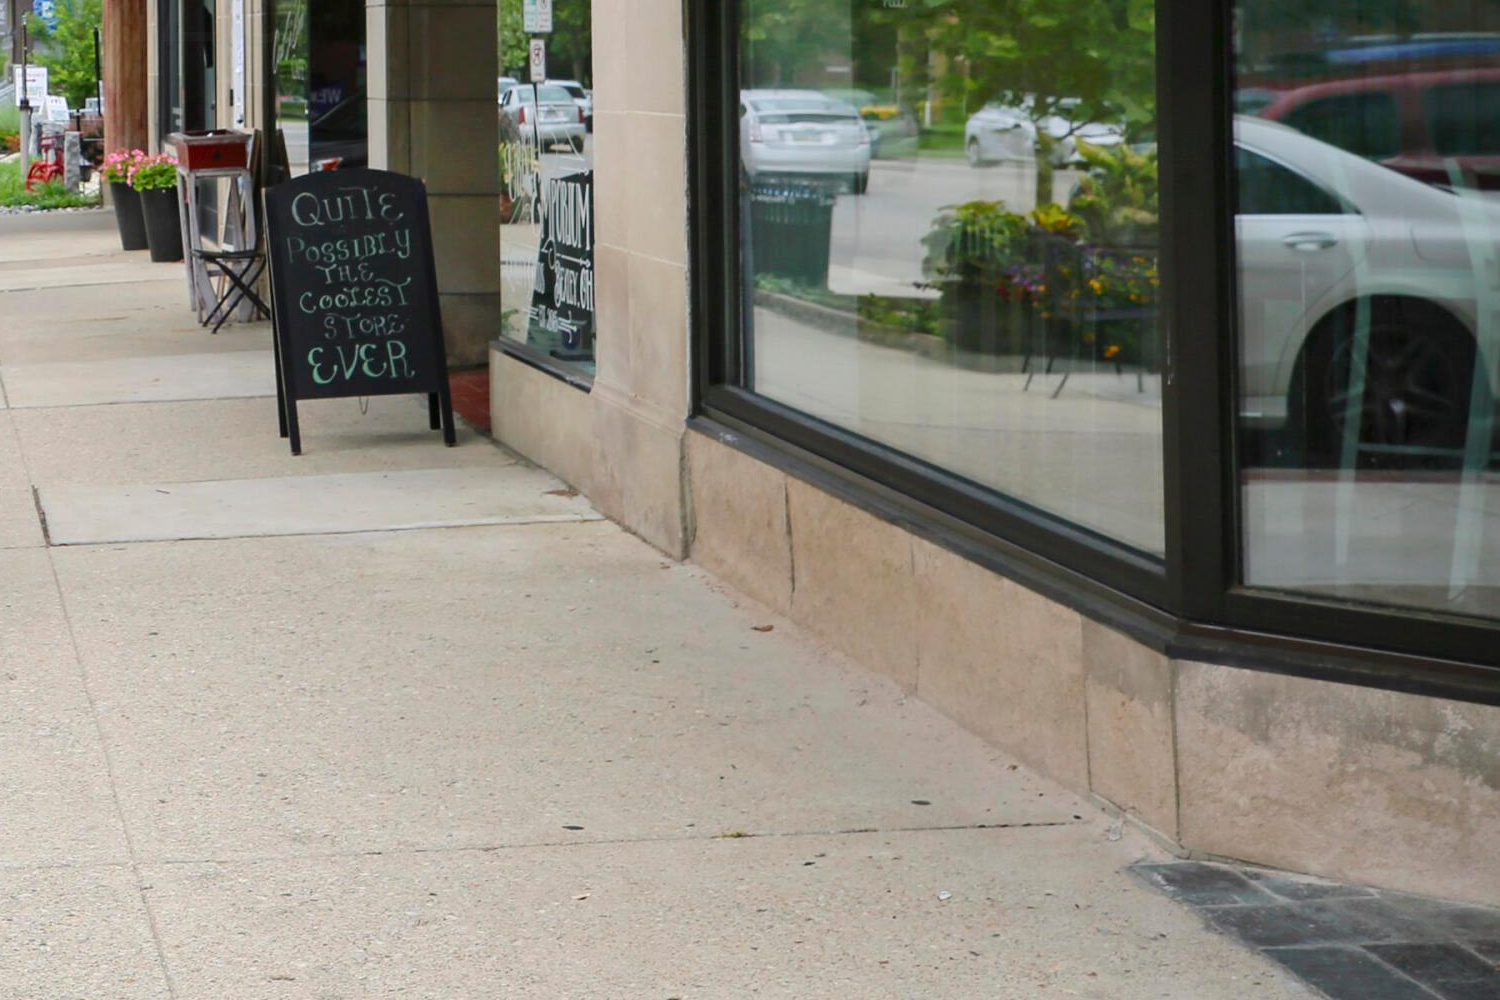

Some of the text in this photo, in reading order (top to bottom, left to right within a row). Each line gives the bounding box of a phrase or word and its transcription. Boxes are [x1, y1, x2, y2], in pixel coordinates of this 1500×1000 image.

[291, 186, 404, 227] QUITE
[286, 229, 411, 264] POSSIBLY
[315, 261, 374, 285] THE
[299, 277, 411, 314] COOLEST
[324, 312, 404, 340] STORE
[307, 340, 416, 385] EVER
